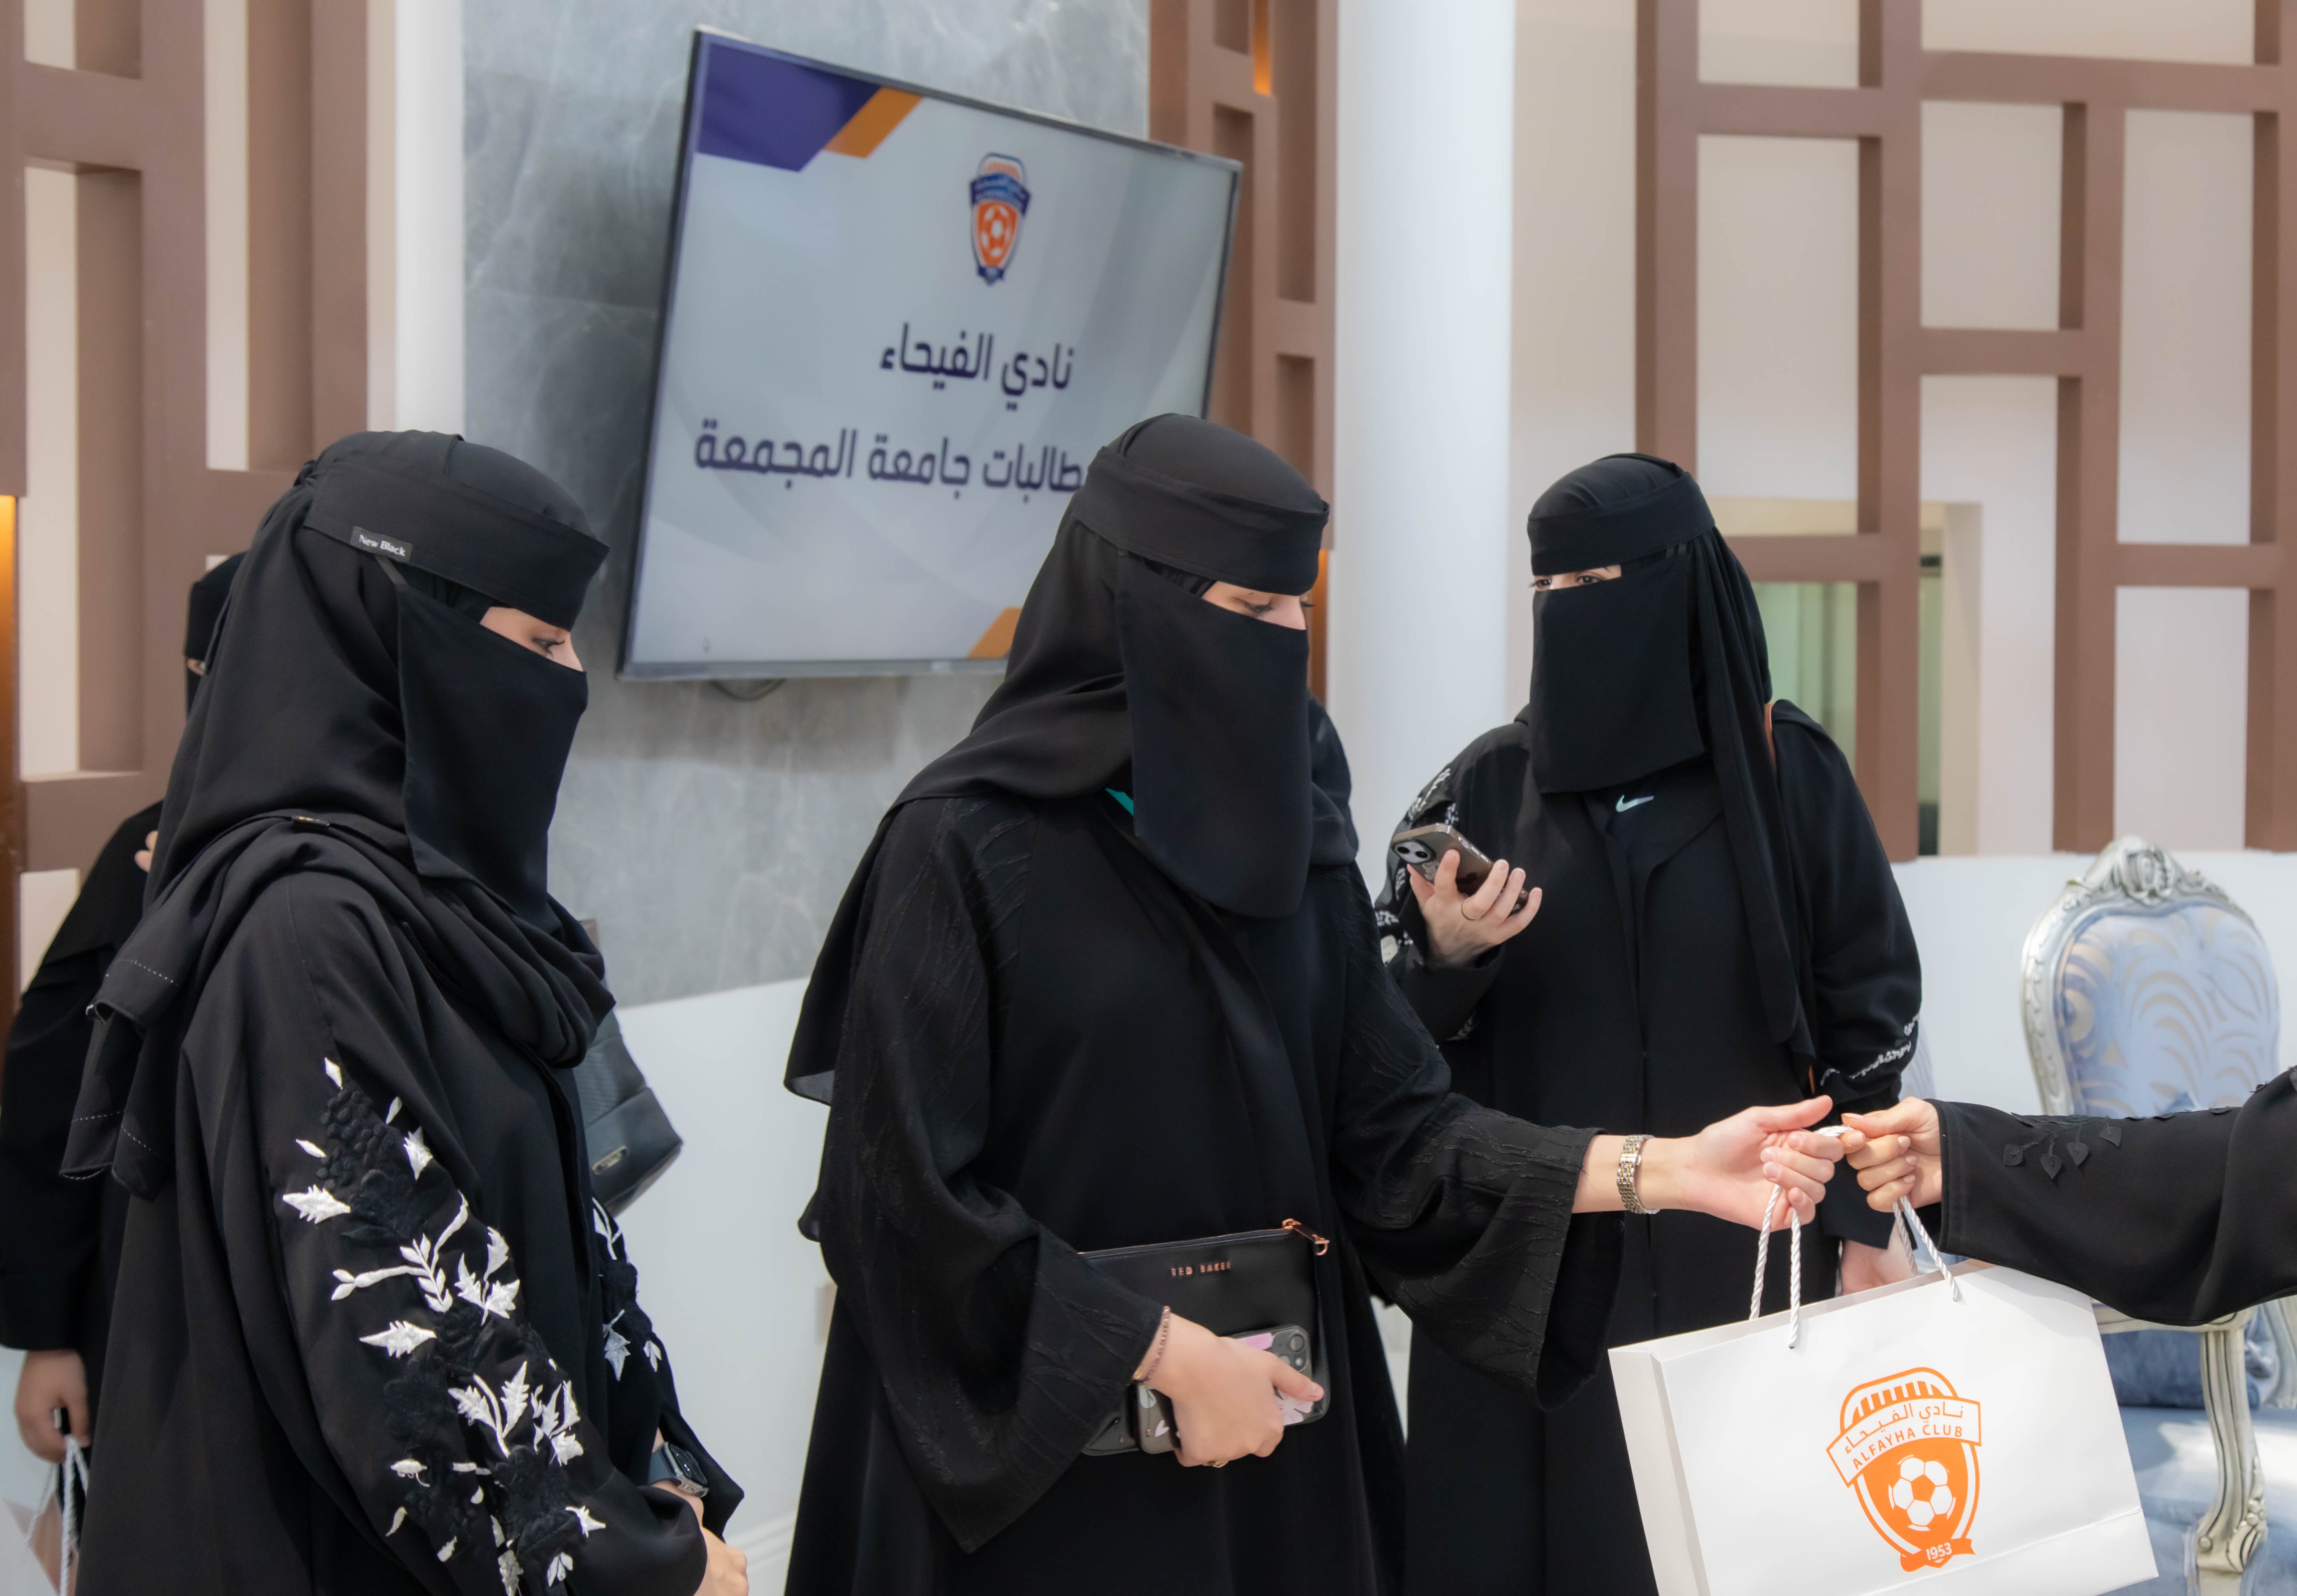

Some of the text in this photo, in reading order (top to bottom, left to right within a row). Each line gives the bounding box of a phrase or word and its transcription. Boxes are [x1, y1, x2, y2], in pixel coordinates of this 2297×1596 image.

[879, 322, 1075, 411] نادي الفيحاء
[694, 418, 1082, 505] طالبات جامعة المجمعة
[359, 534, 405, 556] New Black
[1171, 1267, 1193, 1277] TED
[1845, 1402, 1963, 1454] نادي الفيحاء
[1853, 1424, 1963, 1470] ALFAYHA CLUB
[1925, 1543, 1953, 1561] 1953
